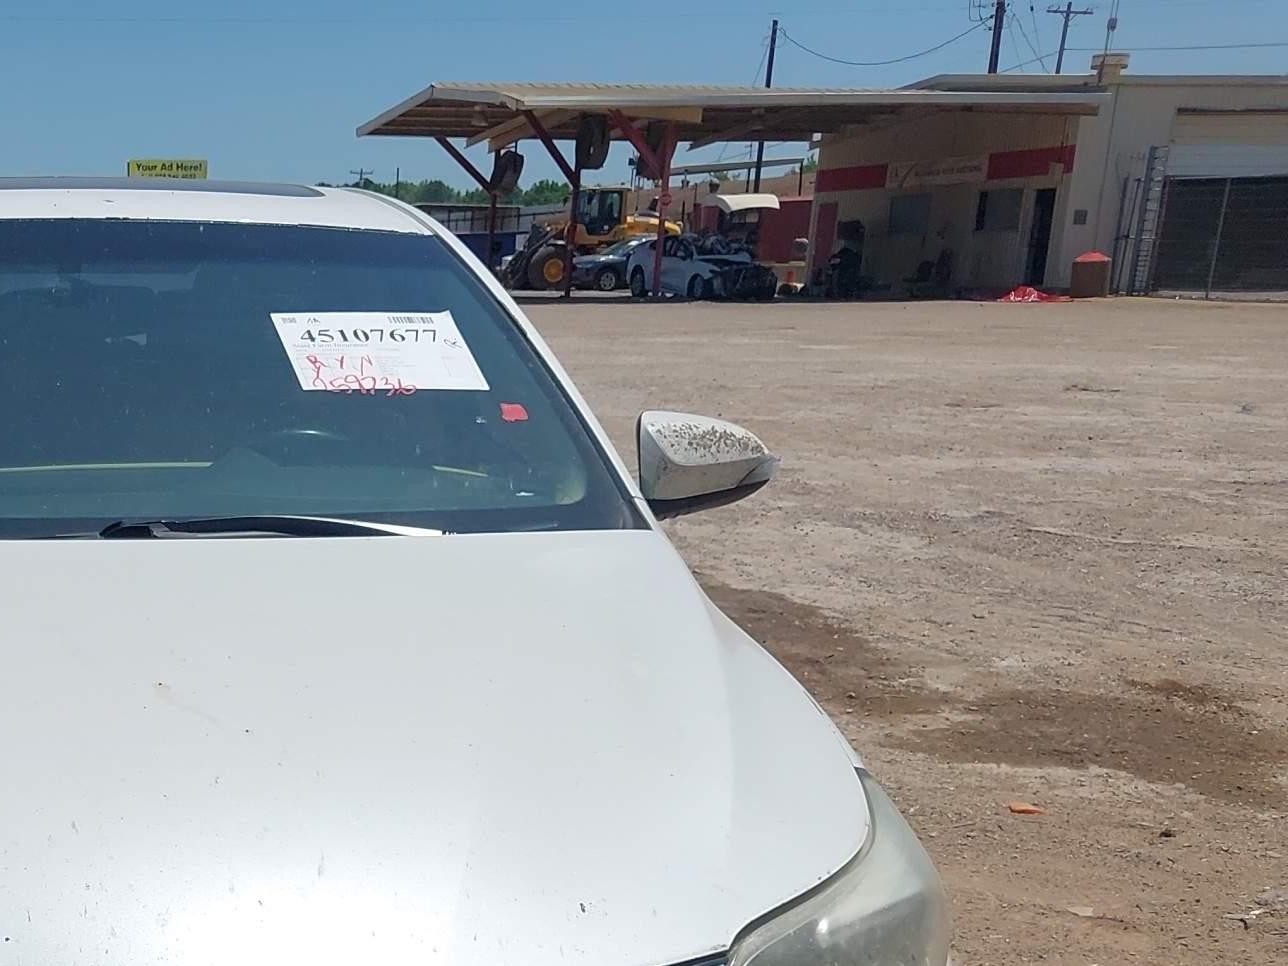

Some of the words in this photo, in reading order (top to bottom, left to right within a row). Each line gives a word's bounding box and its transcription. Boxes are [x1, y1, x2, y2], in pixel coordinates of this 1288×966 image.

[136, 162, 157, 172] Your
[160, 162, 173, 172] Ad
[176, 162, 202, 172] Here!
[300, 328, 437, 343] 45107677
